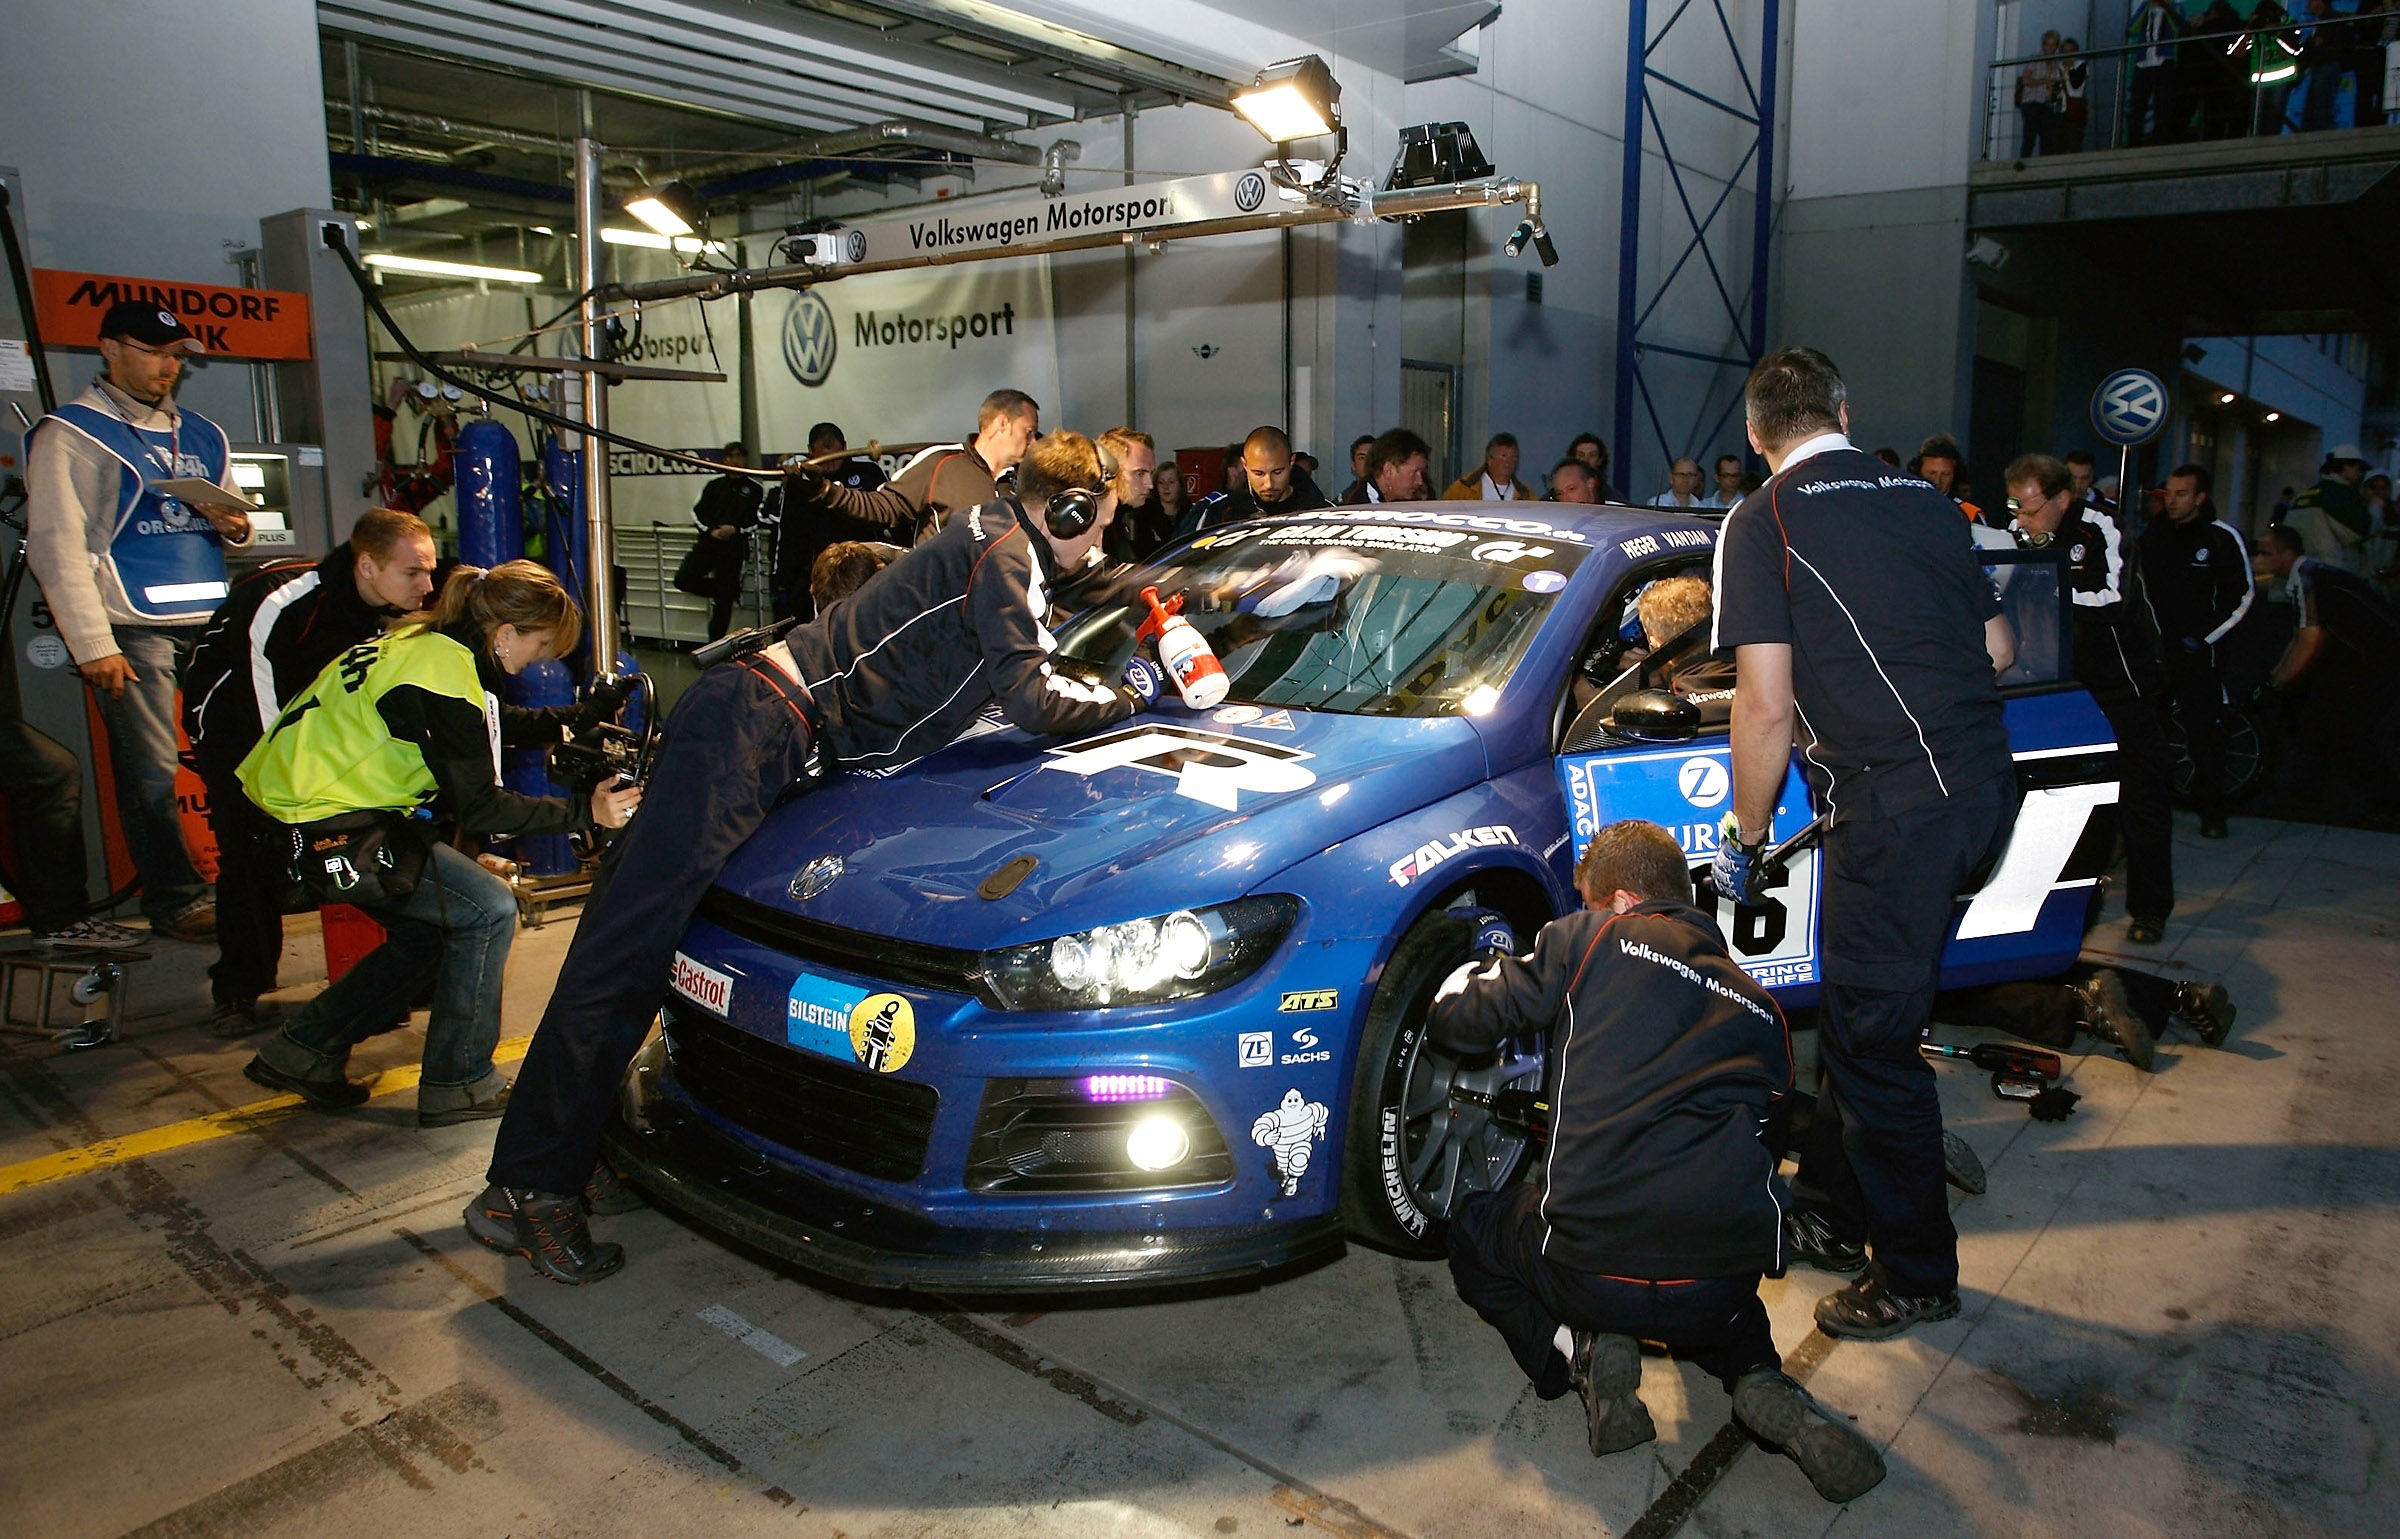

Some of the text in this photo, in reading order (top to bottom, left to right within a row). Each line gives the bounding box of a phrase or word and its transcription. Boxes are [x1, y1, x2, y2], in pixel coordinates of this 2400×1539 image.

[909, 190, 1177, 249] Volkswagen Motorsport
[855, 302, 1015, 349] Motorsport
[1797, 478, 1879, 496] Volkswagen
[258, 533, 286, 542] PLUS
[1071, 510, 1085, 524] OTTO
[1619, 534, 1661, 560] HEGER
[1567, 764, 1593, 837] ADAC
[1388, 825, 1520, 888] FALKEN
[678, 959, 726, 1008] Castrol
[1278, 991, 1338, 1010] ATS
[1619, 938, 1774, 1025] Volkswagen Motorsport
[1281, 1050, 1331, 1065] SACHS
[1382, 1111, 1415, 1224] MICHELIN
